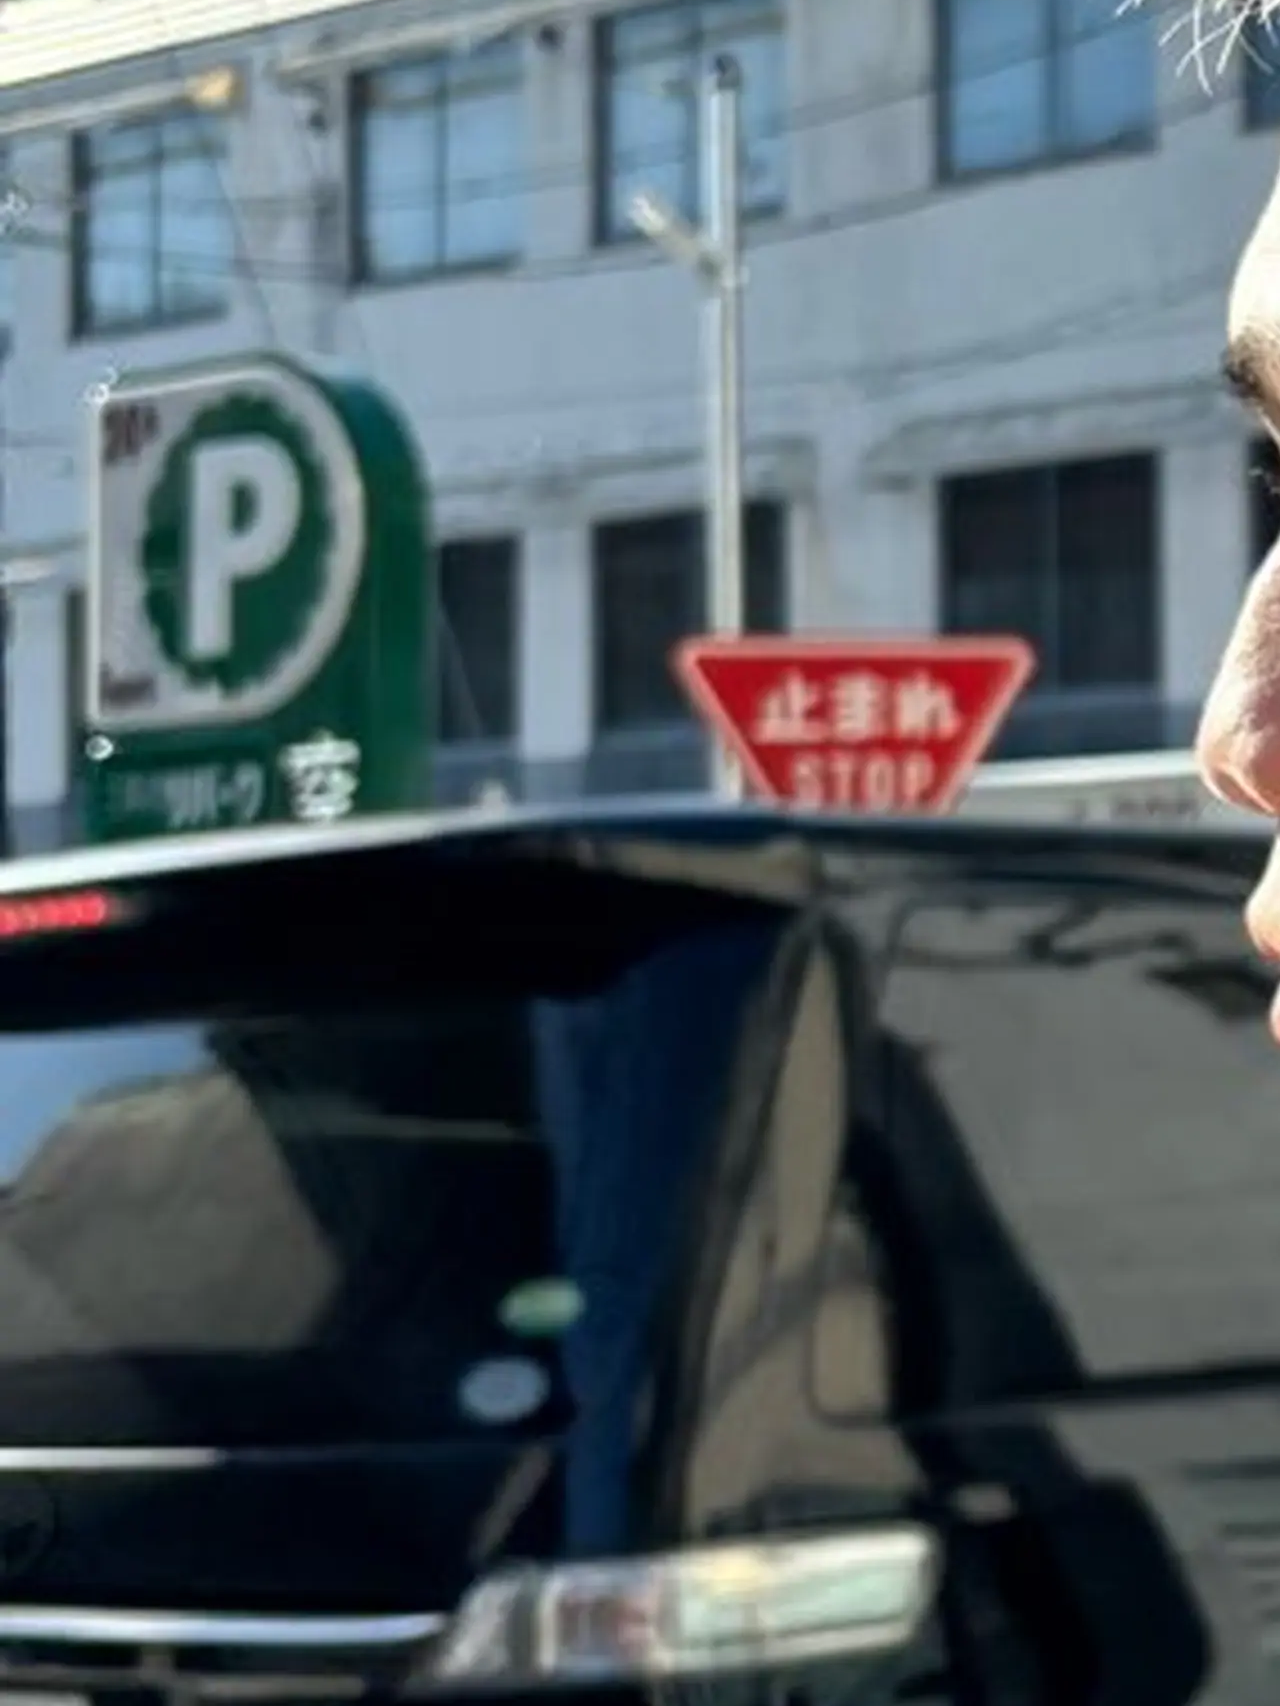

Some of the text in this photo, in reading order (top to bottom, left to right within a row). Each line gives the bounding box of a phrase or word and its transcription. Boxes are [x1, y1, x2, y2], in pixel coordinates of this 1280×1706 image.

[190, 439, 299, 657] P
[754, 670, 963, 744] 止まれ
[790, 751, 935, 812] STOP
